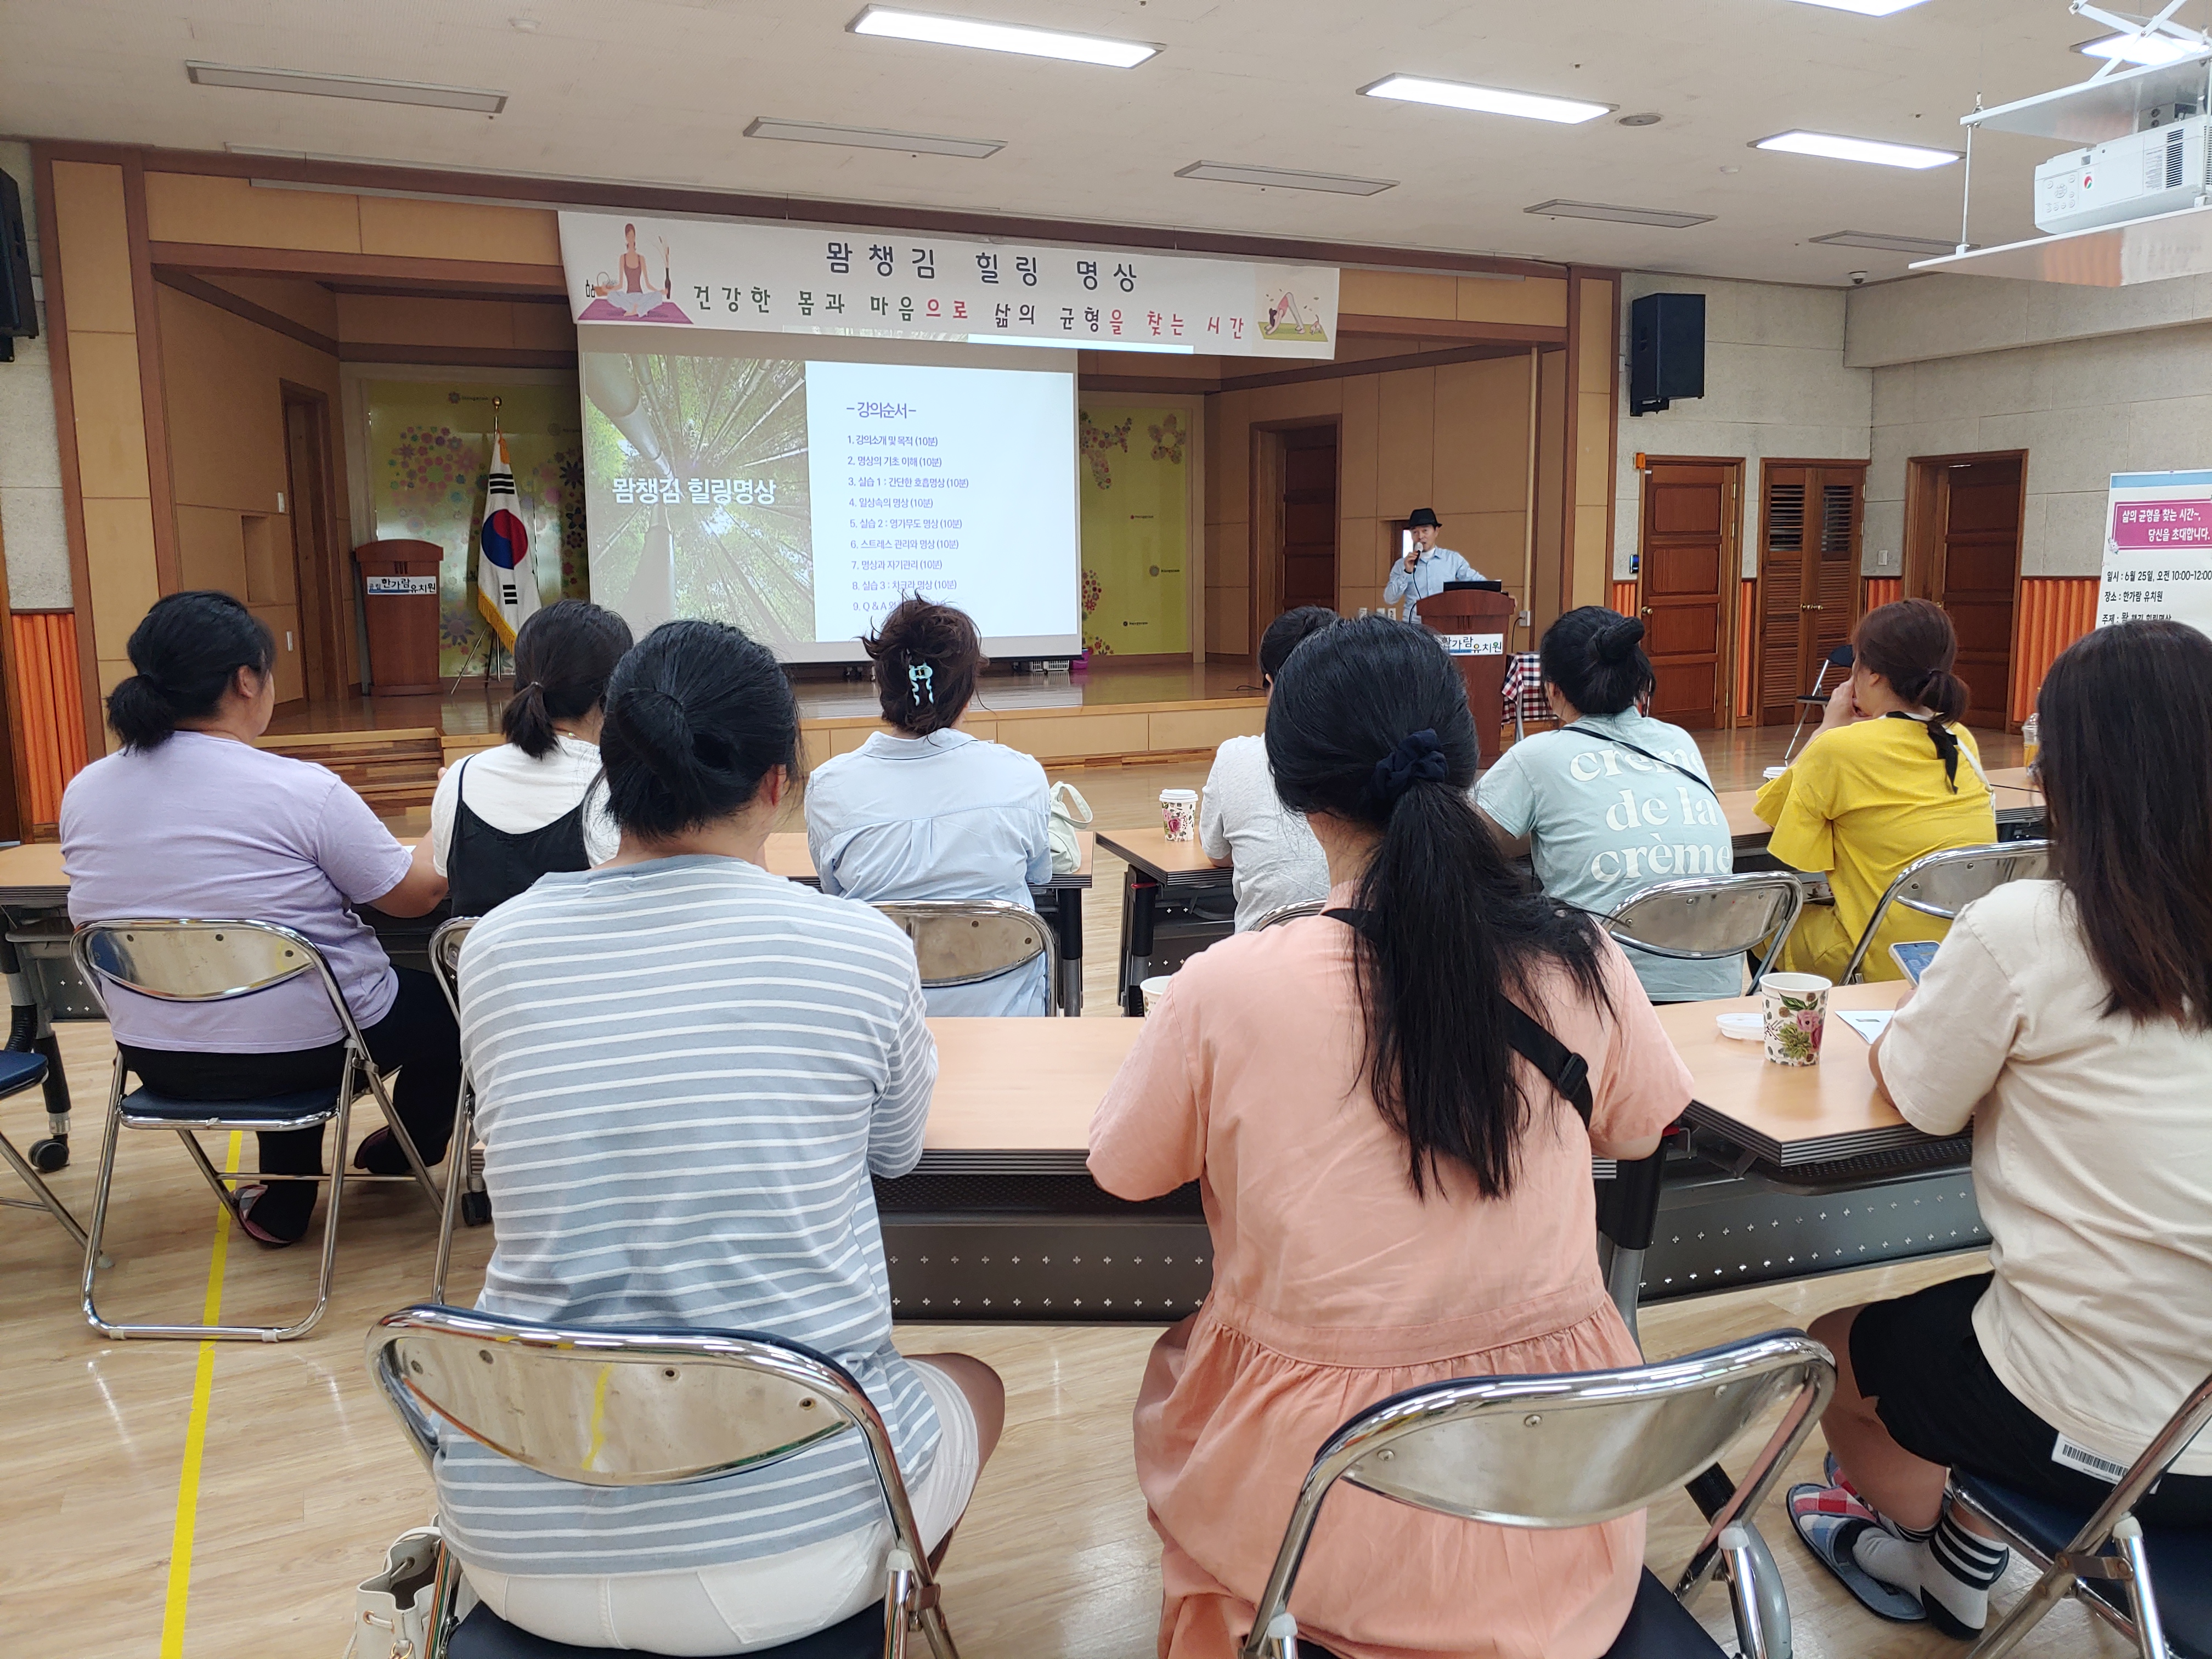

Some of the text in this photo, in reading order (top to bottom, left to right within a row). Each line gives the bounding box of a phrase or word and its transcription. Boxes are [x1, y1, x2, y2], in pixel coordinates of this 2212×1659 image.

[975, 252, 1037, 286] 힐링
[1077, 260, 1136, 292] 명상
[694, 285, 1244, 339] 건강한 몸과 마음으로 삶의 균형을 찾는 시간
[848, 435, 938, 447] 1. 강의소개 및 목적 (10분)
[848, 456, 941, 467] 2. 명상의 기초 이해 (10분)
[848, 477, 856, 486] 3.
[859, 477, 874, 487] 실습
[889, 477, 912, 487] 간단한
[947, 478, 968, 488] (10분)
[687, 478, 776, 505] 힐링명상
[849, 498, 933, 508] 4. 일상속의 명상 (10분)
[2123, 510, 2136, 523] 삶의
[2138, 509, 2160, 522] 균형을
[2163, 509, 2177, 521] 찾는
[850, 519, 857, 528] 5.
[860, 519, 876, 528] 실습
[878, 520, 883, 528] 2
[923, 519, 938, 529] 명상
[940, 519, 962, 529] (10분)
[2148, 527, 2210, 541] 당신을 초대합니다.
[850, 539, 958, 549] 6. 스트레스 관리와 명상 (10분)
[851, 560, 943, 570] 7. 명상과 자기관리 (10분)
[2107, 571, 2119, 582] 일시
[2125, 571, 2136, 582] 6월
[2138, 571, 2154, 582] 25일,
[2157, 571, 2169, 581] 오전
[2172, 571, 2212, 580] 10:00-12:00
[852, 582, 860, 590] 8.
[862, 581, 878, 591] 실습
[917, 580, 933, 590] 명상
[934, 580, 957, 590] (10분)
[2104, 591, 2117, 602] 장소
[2123, 591, 2142, 602] 한가람
[2143, 591, 2163, 602] 유치원
[863, 602, 870, 611] Q
[1606, 786, 1719, 831] de la
[1591, 833, 1731, 882] crème
